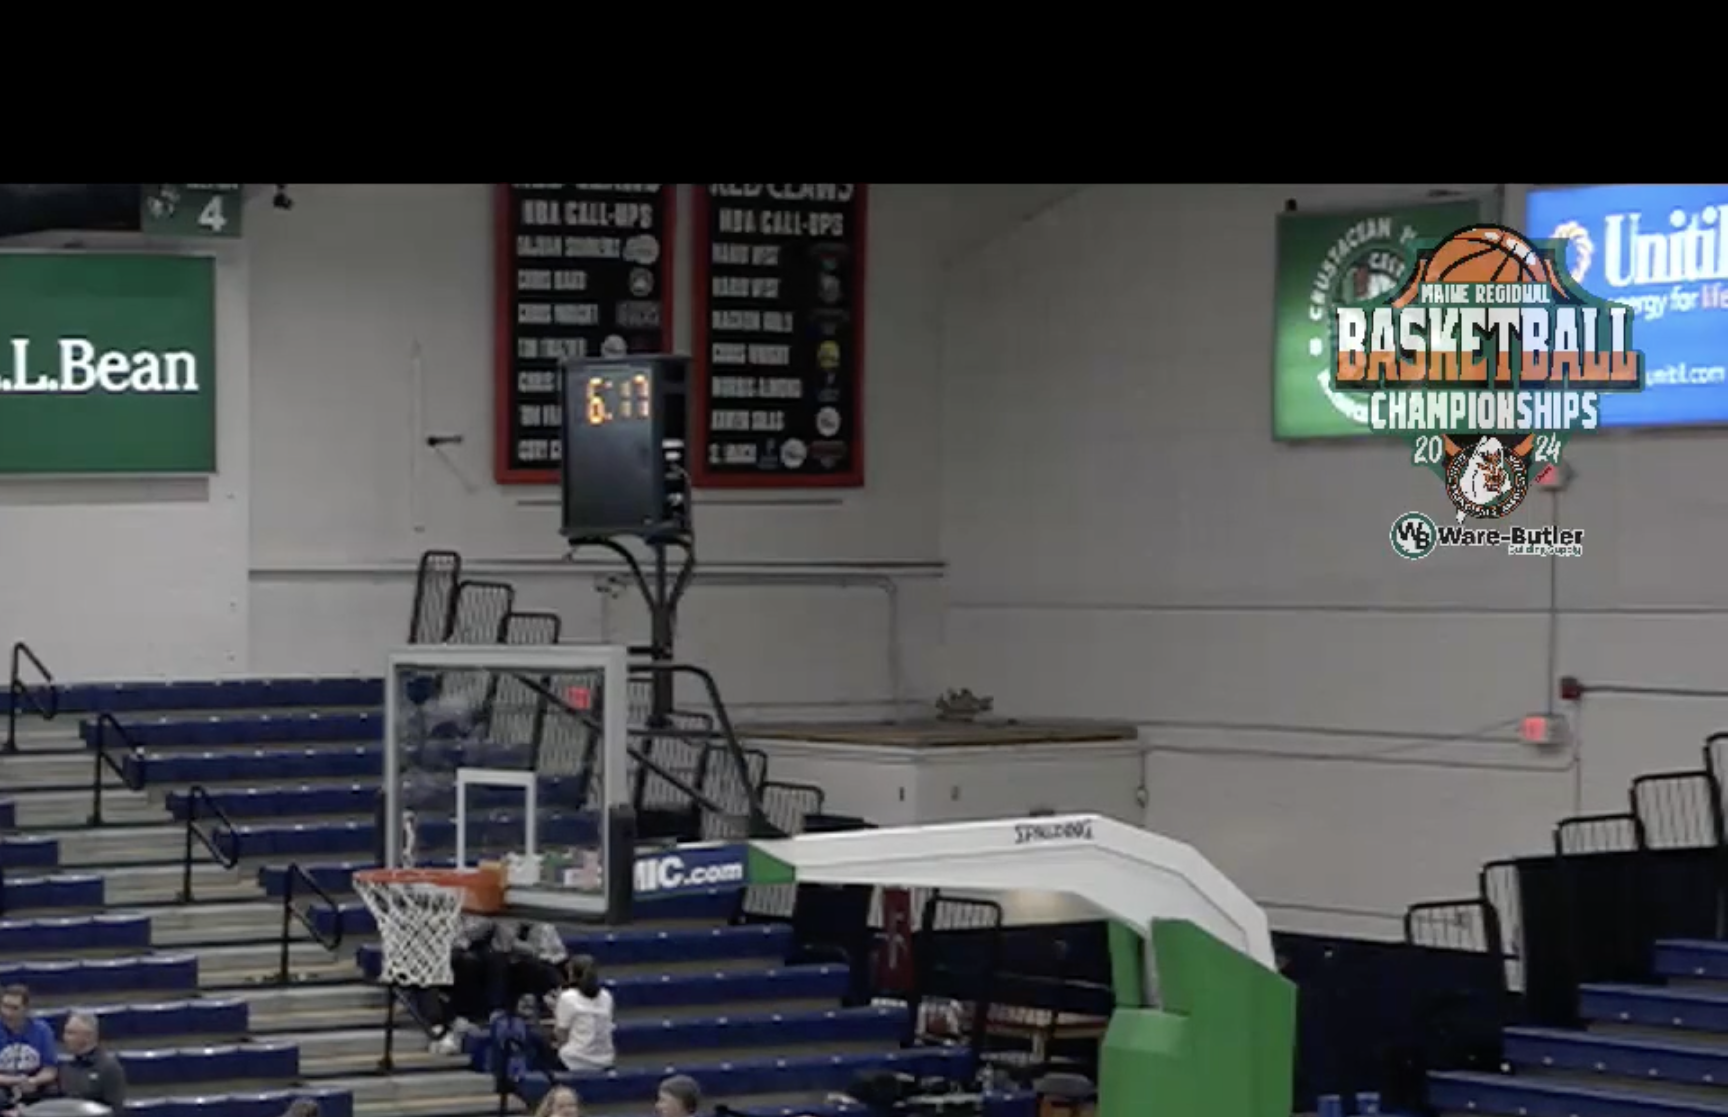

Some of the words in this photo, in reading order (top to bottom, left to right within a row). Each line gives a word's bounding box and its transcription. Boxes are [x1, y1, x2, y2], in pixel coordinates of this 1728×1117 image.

[197, 195, 228, 232] 4
[1671, 285, 1699, 311] for
[586, 374, 649, 425] 6:17
